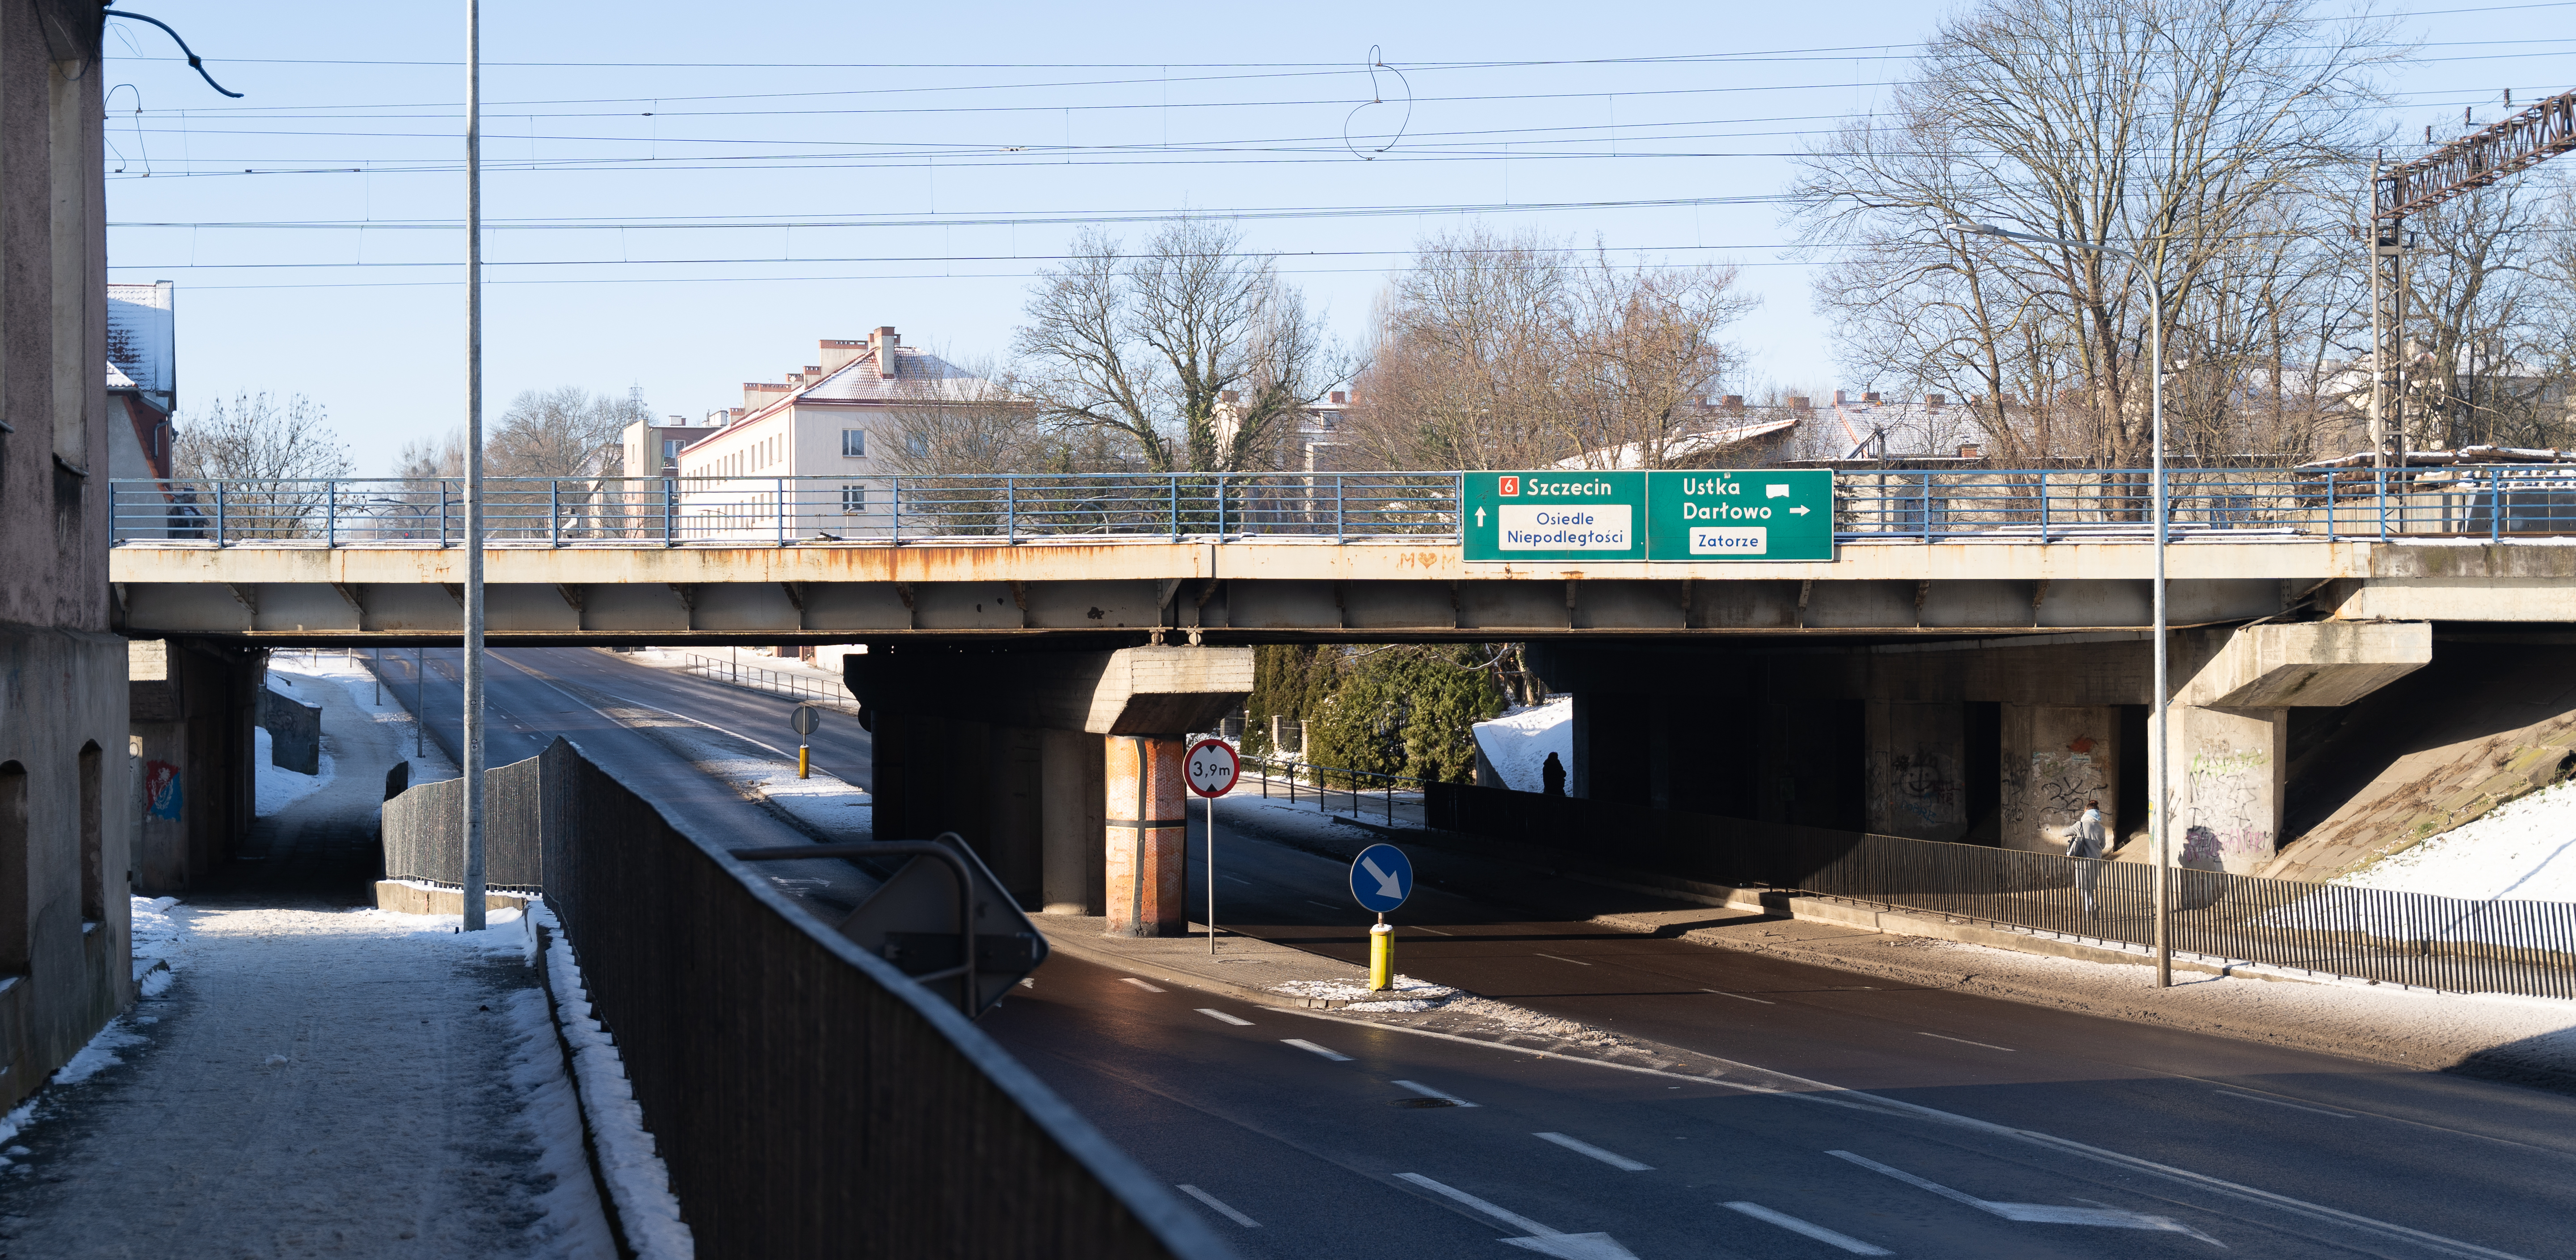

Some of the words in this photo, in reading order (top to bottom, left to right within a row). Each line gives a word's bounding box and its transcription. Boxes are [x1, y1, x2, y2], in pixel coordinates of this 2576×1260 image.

[1504, 479, 1514, 493] 6
[1527, 478, 1611, 496] Szczecin
[1684, 478, 1740, 495] Ustka
[1537, 512, 1594, 525] Osiedle
[1684, 502, 1772, 519] Darłowo
[1508, 530, 1623, 546] Niepodległości
[1699, 534, 1758, 547] Zatorze
